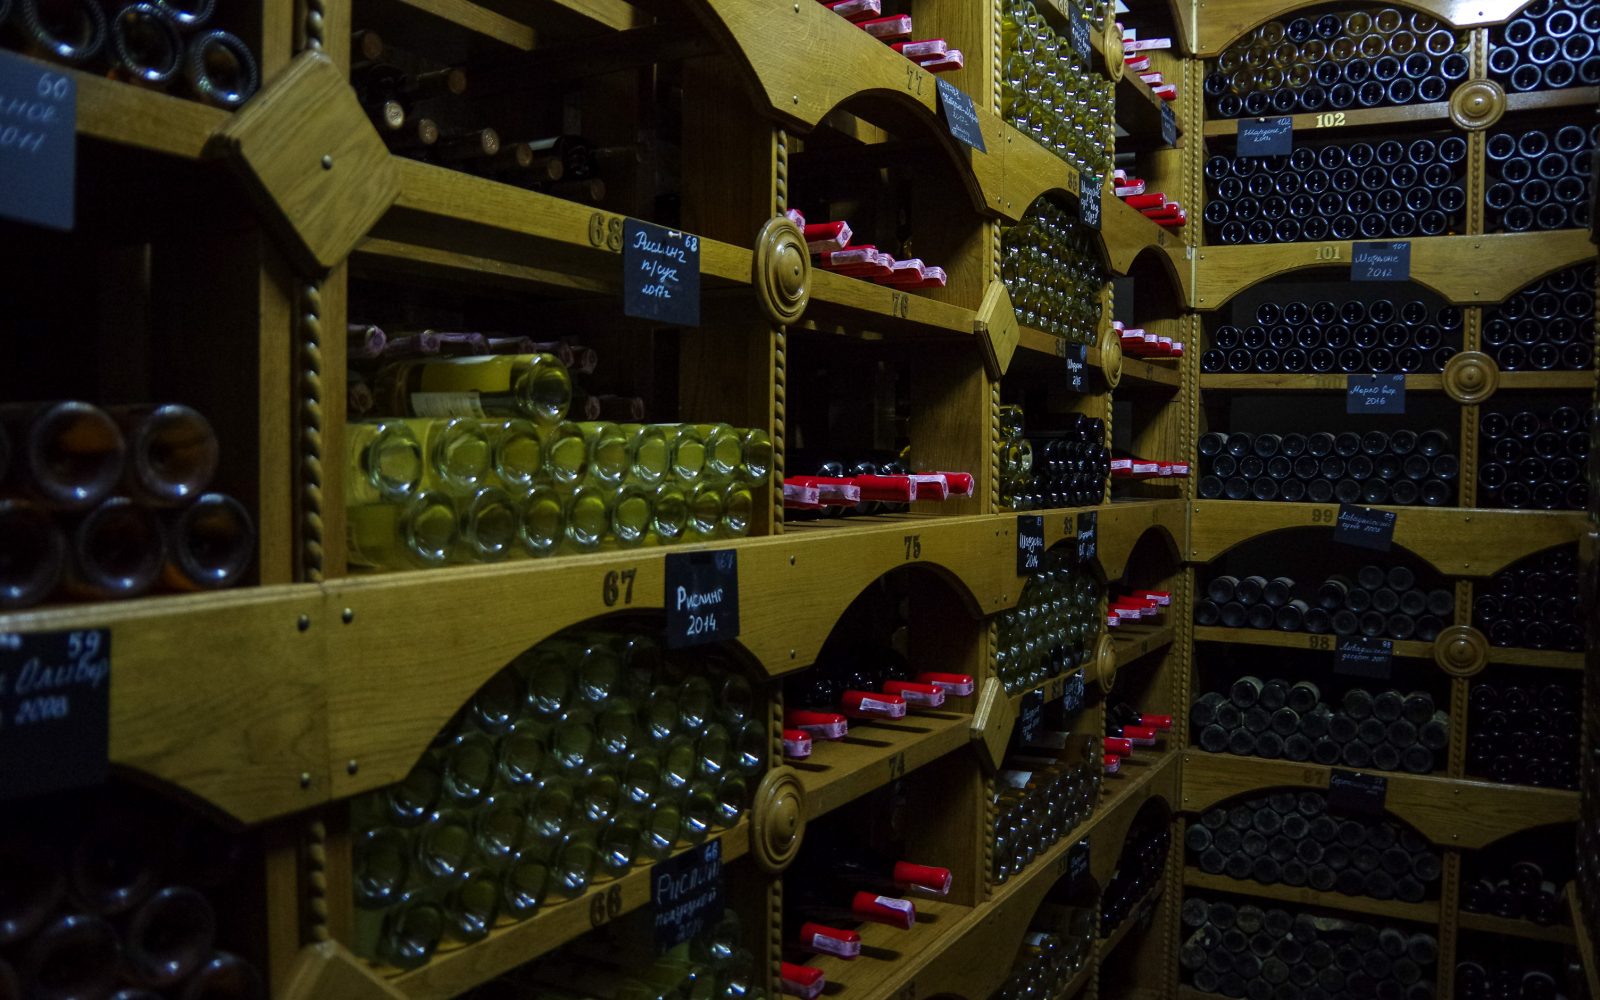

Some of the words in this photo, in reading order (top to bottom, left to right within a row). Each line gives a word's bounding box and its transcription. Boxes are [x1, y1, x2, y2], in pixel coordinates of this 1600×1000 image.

[1277, 118, 1291, 126] 102
[1316, 112, 1346, 128] 102
[589, 213, 624, 252] 68
[685, 235, 698, 253] 68
[1314, 246, 1341, 260] 101
[904, 534, 921, 560] 75
[603, 568, 637, 607] 67
[676, 585, 724, 611] Рислинг
[68, 630, 101, 659] 59
[1310, 635, 1330, 649] 98
